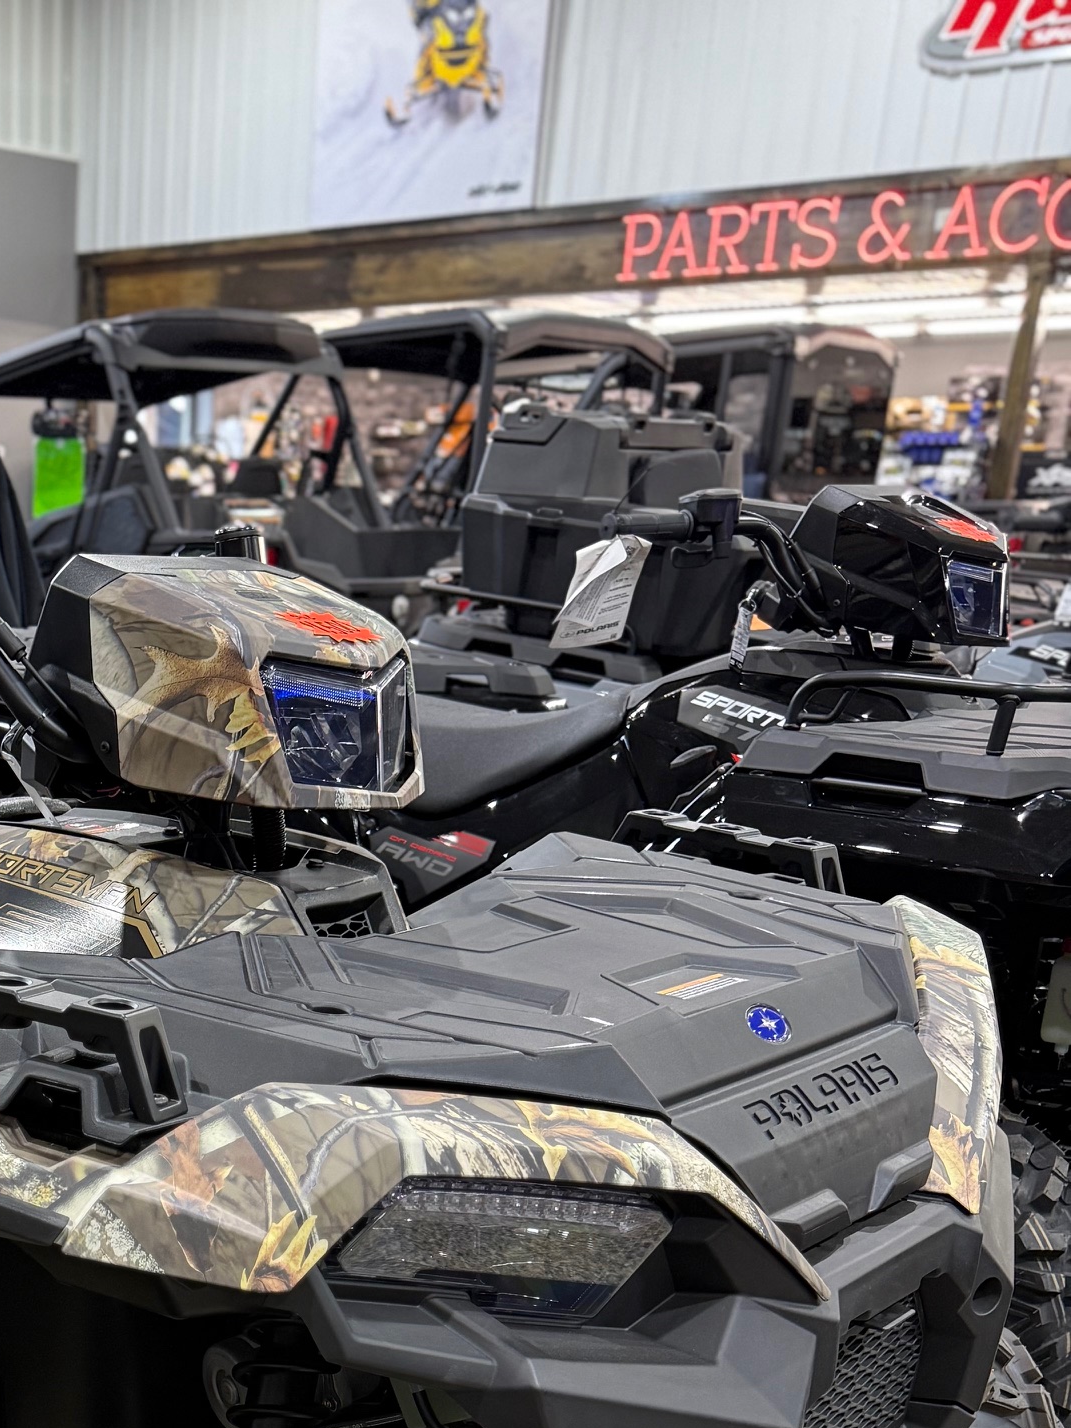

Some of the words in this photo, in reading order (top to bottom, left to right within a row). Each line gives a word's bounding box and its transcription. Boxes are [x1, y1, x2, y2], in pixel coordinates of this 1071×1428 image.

[615, 196, 841, 282] PARTS
[857, 190, 911, 264] &
[576, 621, 620, 635] POLARIS
[375, 841, 455, 877] AWD
[742, 1052, 900, 1140] POLARIS
